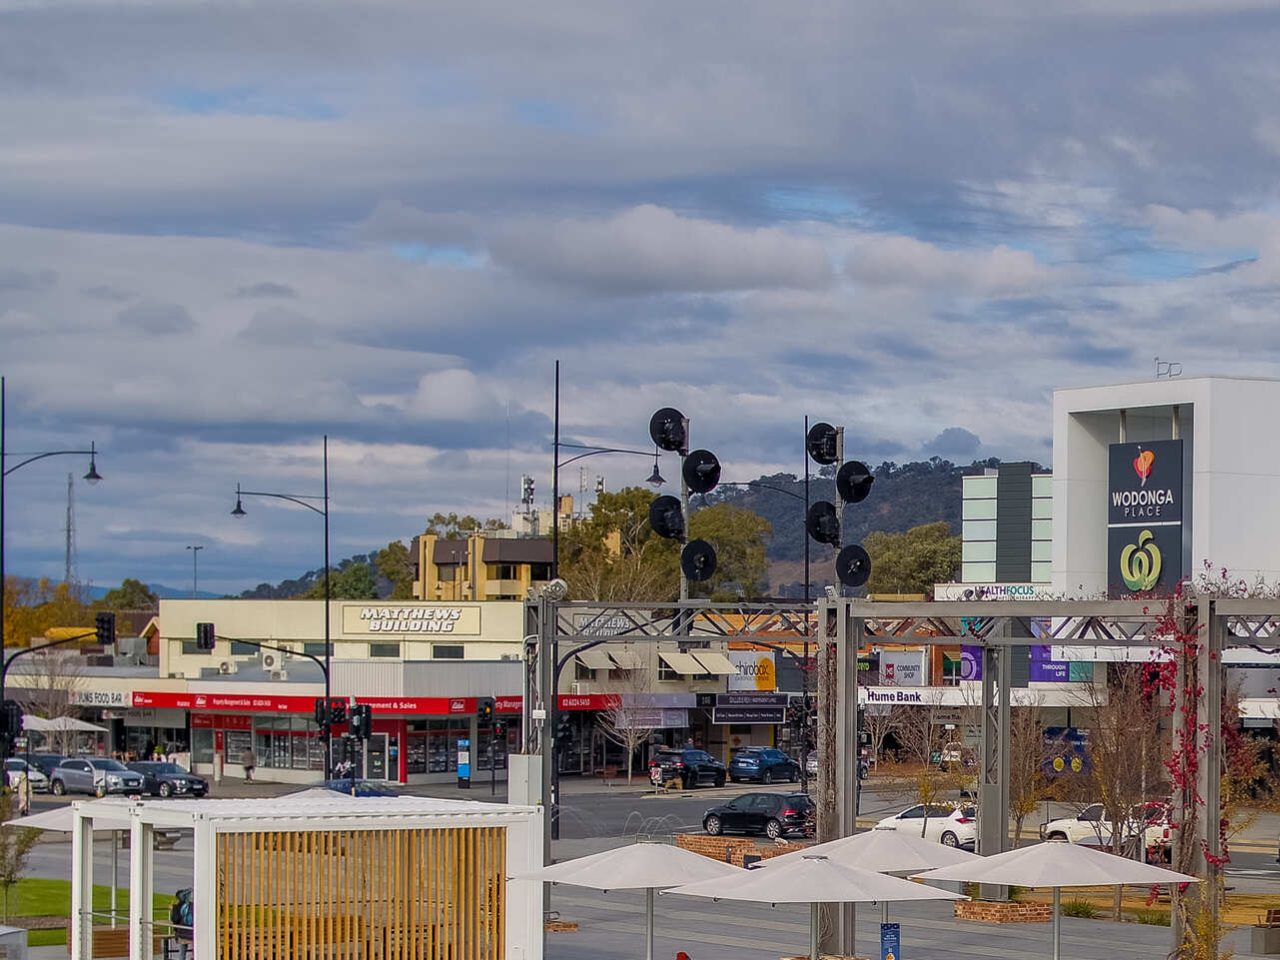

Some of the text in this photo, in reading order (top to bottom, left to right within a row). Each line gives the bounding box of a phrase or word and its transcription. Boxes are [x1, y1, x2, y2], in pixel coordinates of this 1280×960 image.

[1112, 490, 1174, 506] WODONGA
[1124, 506, 1161, 517] PLACE
[361, 608, 462, 620] MATTHEWS
[369, 620, 455, 632] BUILDING
[896, 664, 920, 672] COMMUNITY
[867, 691, 921, 702] Hume Bank
